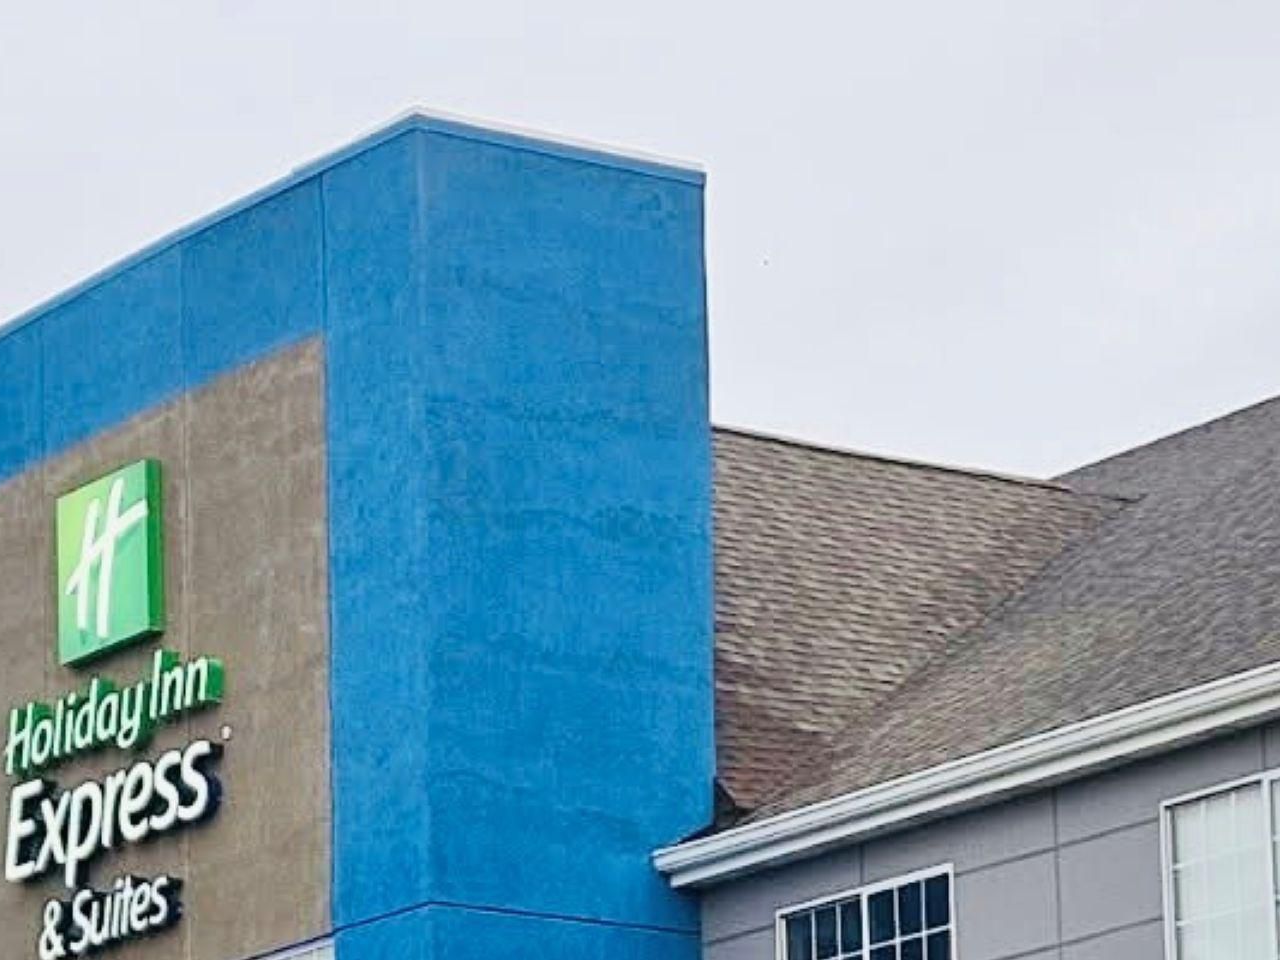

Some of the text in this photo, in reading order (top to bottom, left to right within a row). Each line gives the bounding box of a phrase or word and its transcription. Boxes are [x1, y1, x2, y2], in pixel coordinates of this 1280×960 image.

[65, 478, 148, 638] H
[5, 649, 210, 775] Holiday Inn
[5, 740, 211, 887] Express
[70, 876, 168, 955] Suites
